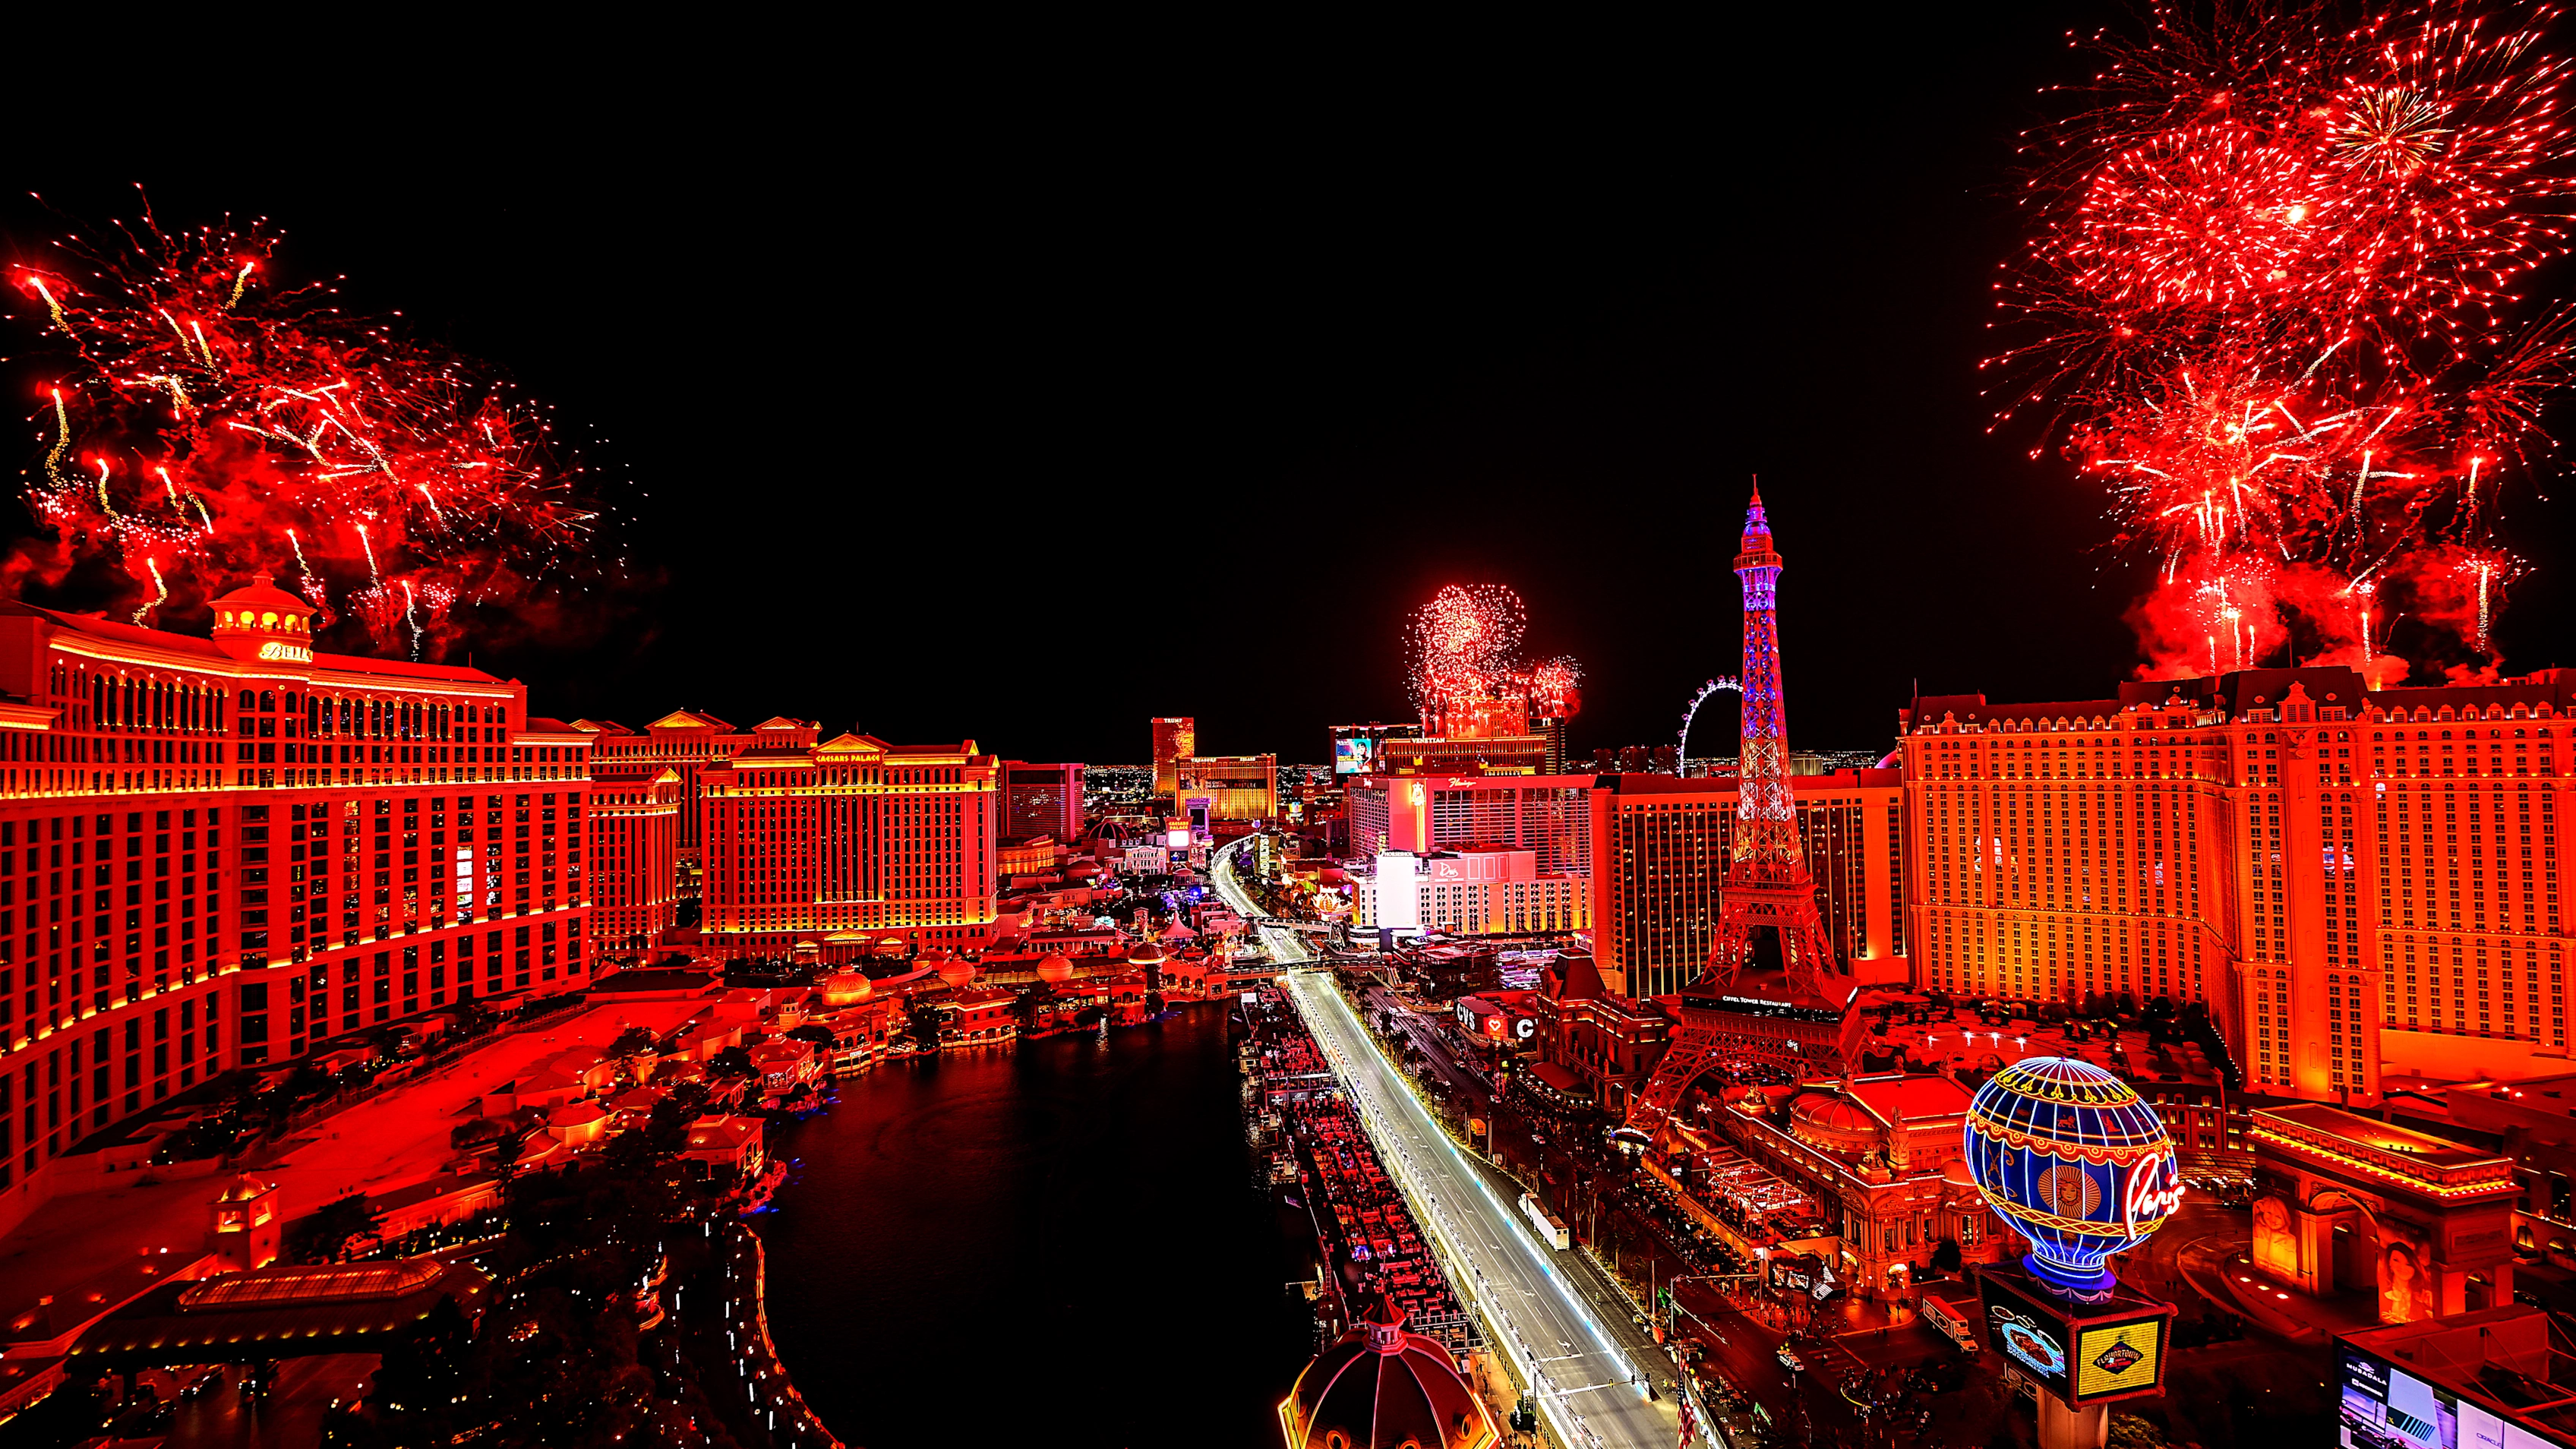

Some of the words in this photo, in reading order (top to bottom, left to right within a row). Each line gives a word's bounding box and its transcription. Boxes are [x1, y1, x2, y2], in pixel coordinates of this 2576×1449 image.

[1760, 999, 1792, 1008] RESTAURANT
[1457, 1002, 1475, 1030] CVS
[1683, 1130, 1694, 1143] BEER
[1694, 1138, 1706, 1151] PARK
[2124, 1152, 2186, 1241] Paris
[2346, 1363, 2387, 1385] MUBADALA
[2477, 1432, 2502, 1447] ORACLE
